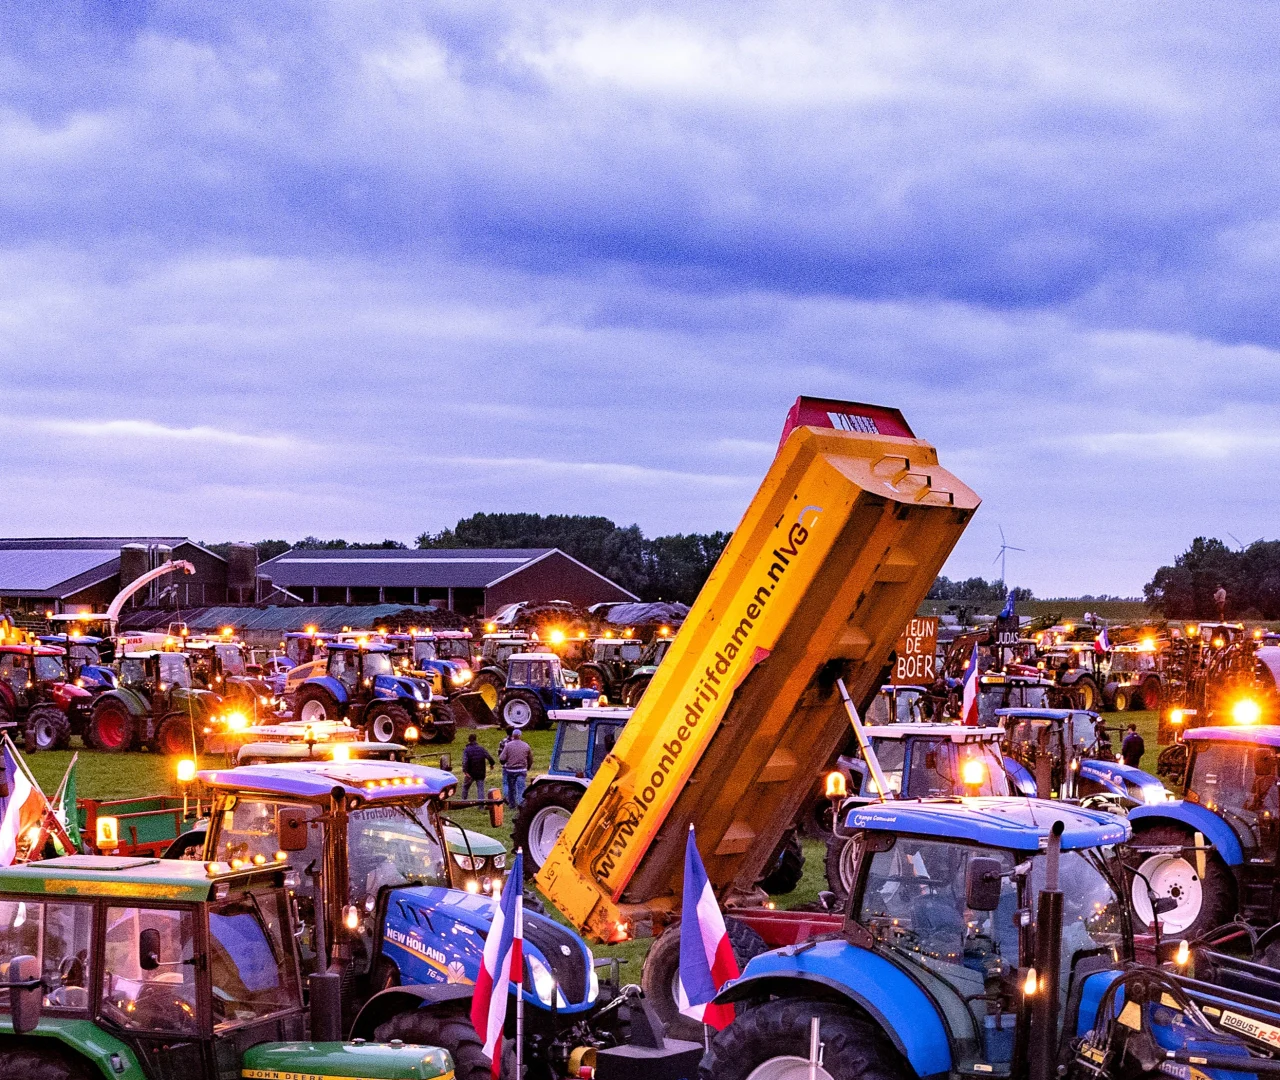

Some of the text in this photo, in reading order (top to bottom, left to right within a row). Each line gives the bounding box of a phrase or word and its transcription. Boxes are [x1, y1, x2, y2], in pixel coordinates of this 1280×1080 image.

[901, 619, 934, 638] TEUN
[996, 631, 1019, 645] JUDAS
[905, 638, 921, 654] DE
[897, 655, 934, 679] BOER
[596, 550, 789, 880] www.loonbedrijfdamen.nl
[387, 927, 446, 964] NEW HOLLAND
[1224, 1014, 1258, 1034] ROBUST
[1257, 1031, 1265, 1039] F
[249, 1071, 279, 1079] JOHN
